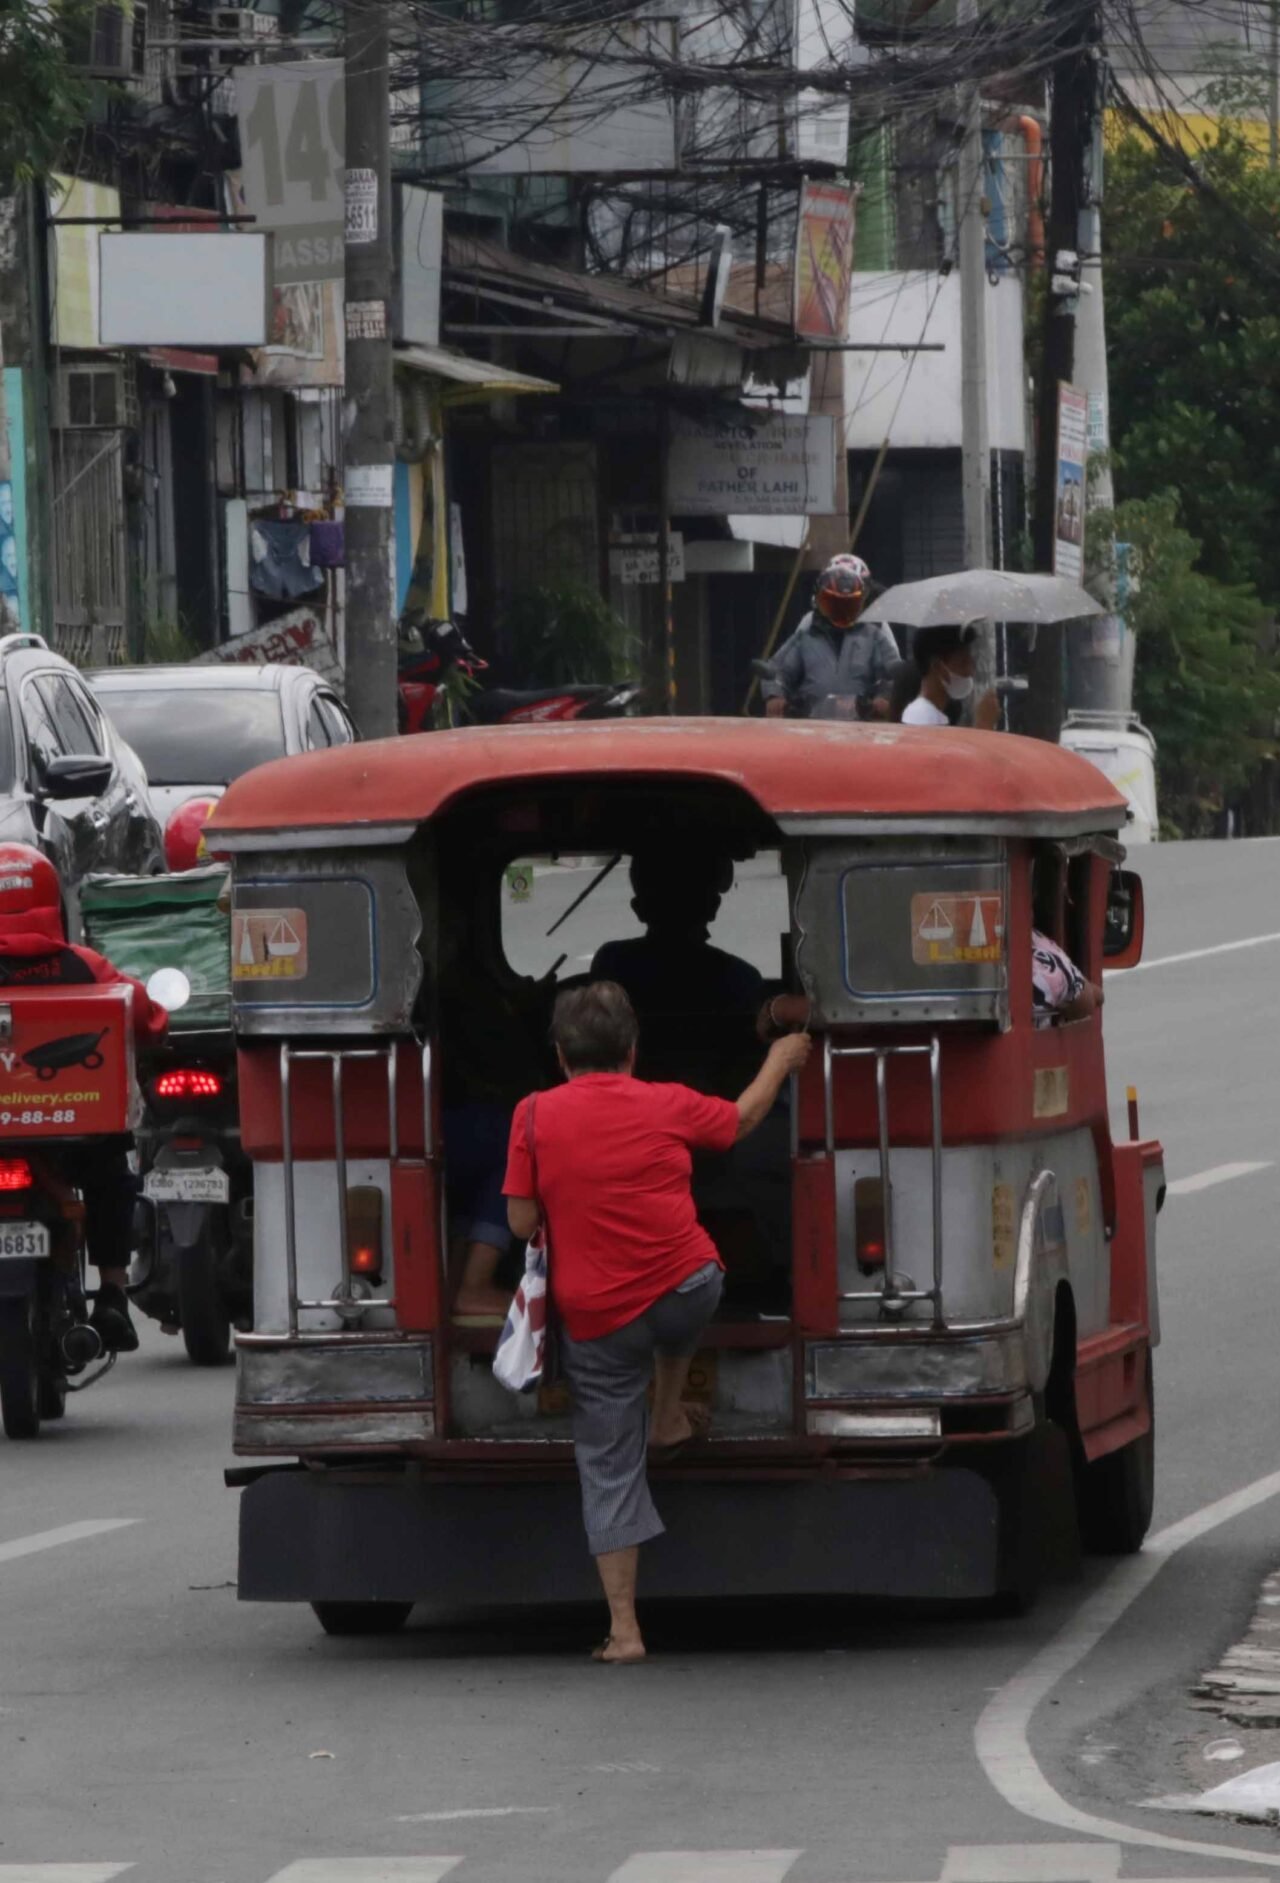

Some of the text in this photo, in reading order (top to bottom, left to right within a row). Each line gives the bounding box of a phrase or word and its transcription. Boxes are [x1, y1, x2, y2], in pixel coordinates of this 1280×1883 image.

[737, 466, 758, 480] OF
[763, 482, 798, 493] LAHI
[0, 1091, 100, 1107] elivery.com
